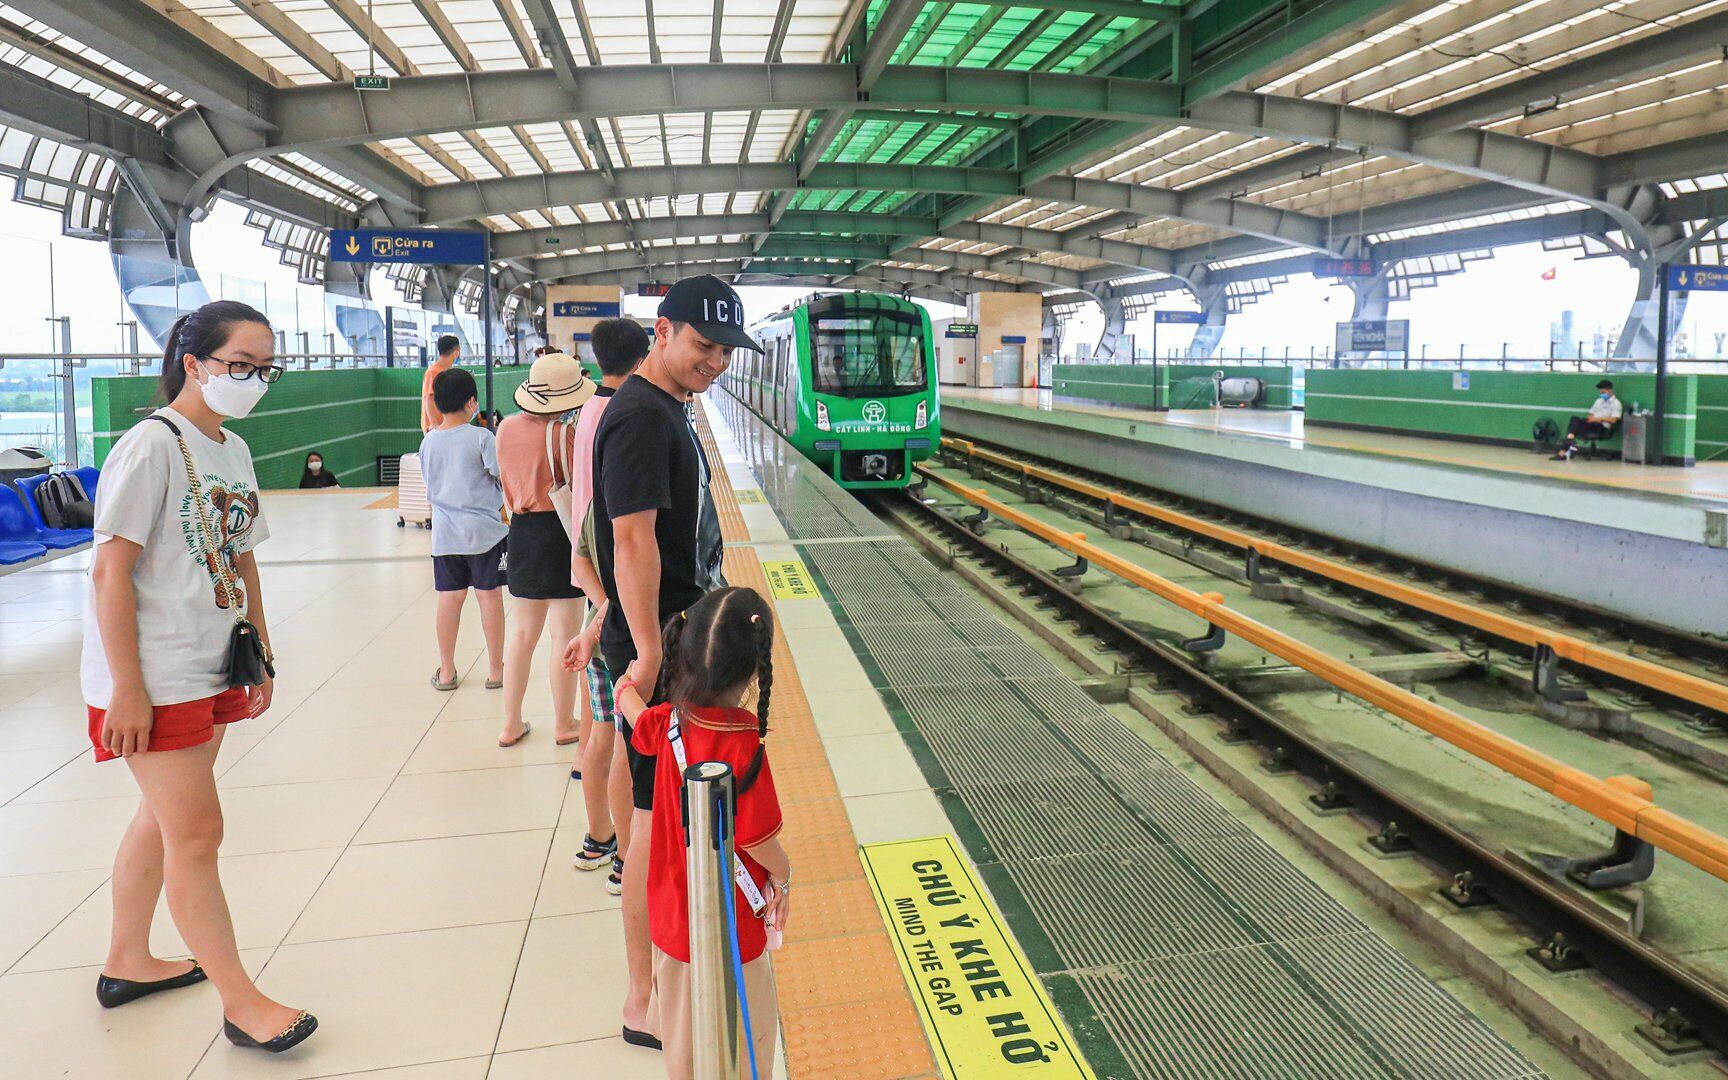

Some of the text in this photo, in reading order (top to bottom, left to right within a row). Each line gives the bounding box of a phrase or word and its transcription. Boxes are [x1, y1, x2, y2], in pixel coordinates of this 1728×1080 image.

[395, 237, 434, 248] Cửa ra
[894, 897, 963, 1016] MIND THE GAP
[912, 859, 1059, 1065] CHÚ Ý KHE HỞ
